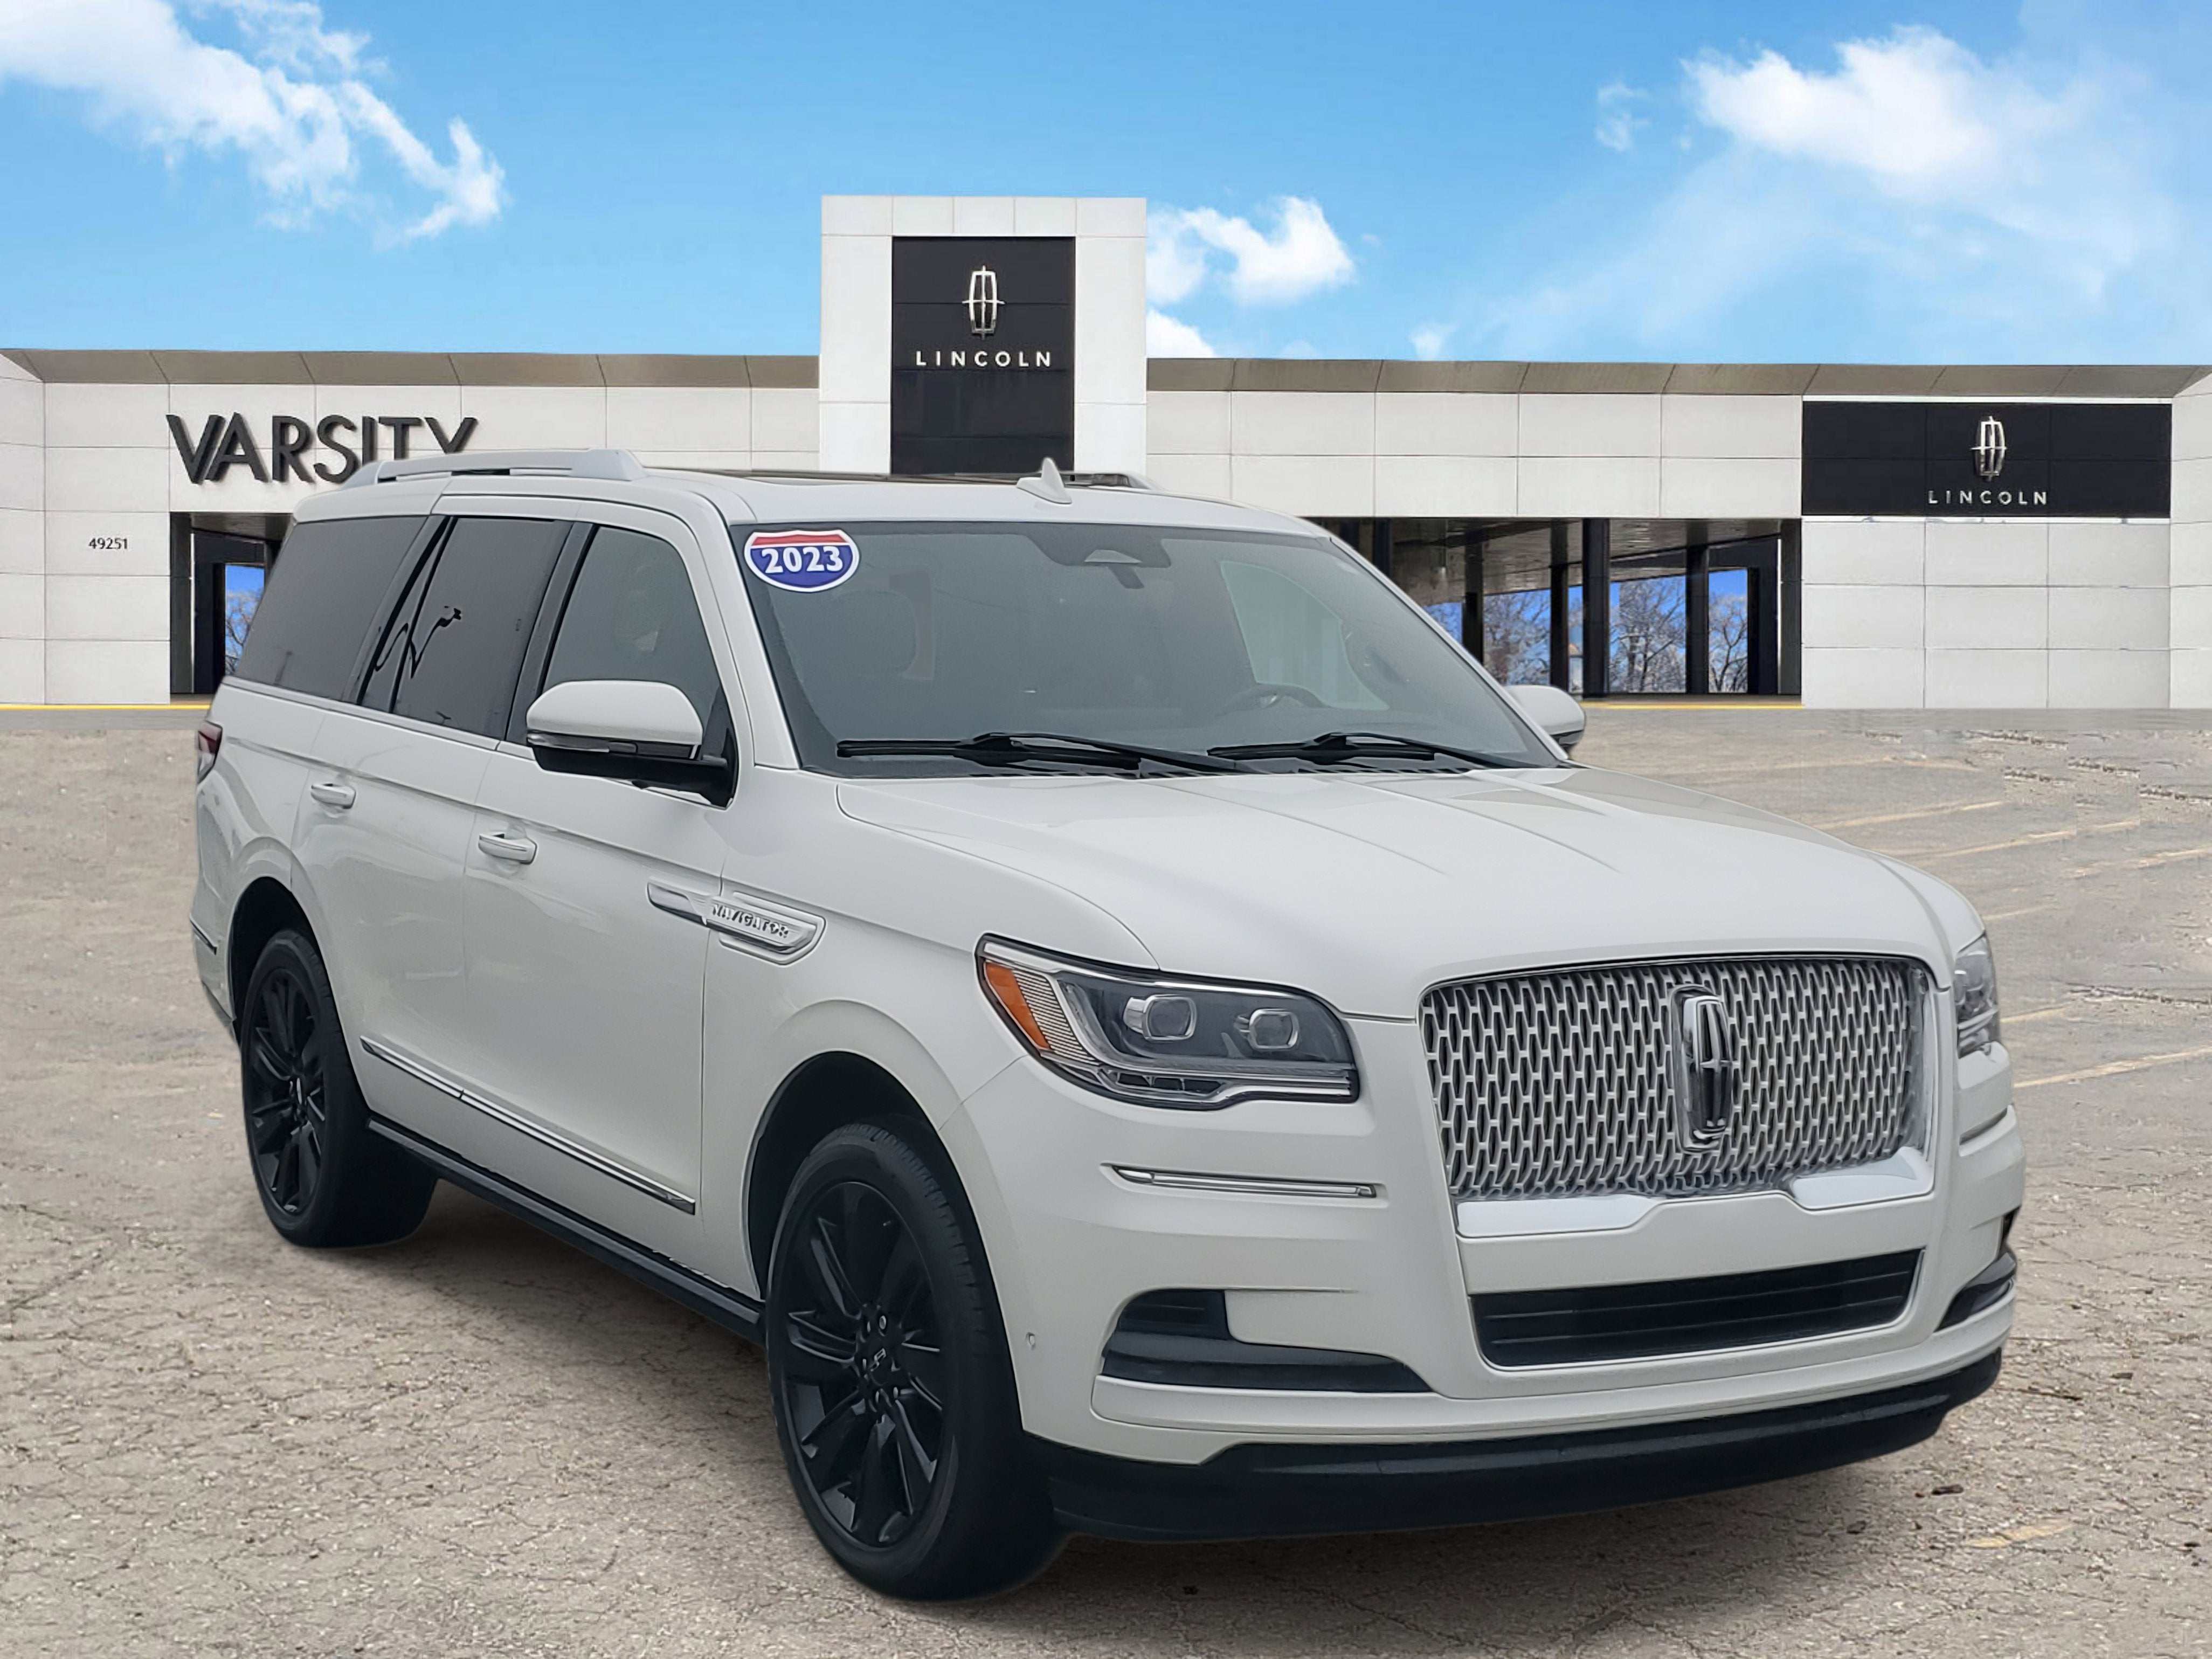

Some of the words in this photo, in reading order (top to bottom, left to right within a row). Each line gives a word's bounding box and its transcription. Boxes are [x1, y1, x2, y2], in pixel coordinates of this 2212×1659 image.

[916, 350, 1051, 367] LINCOLN
[166, 412, 478, 485] VARSITY
[1928, 490, 2047, 505] LINCOLN
[88, 537, 127, 549] 49251
[761, 545, 843, 573] 2023
[711, 903, 789, 938] NAVIGATOR
